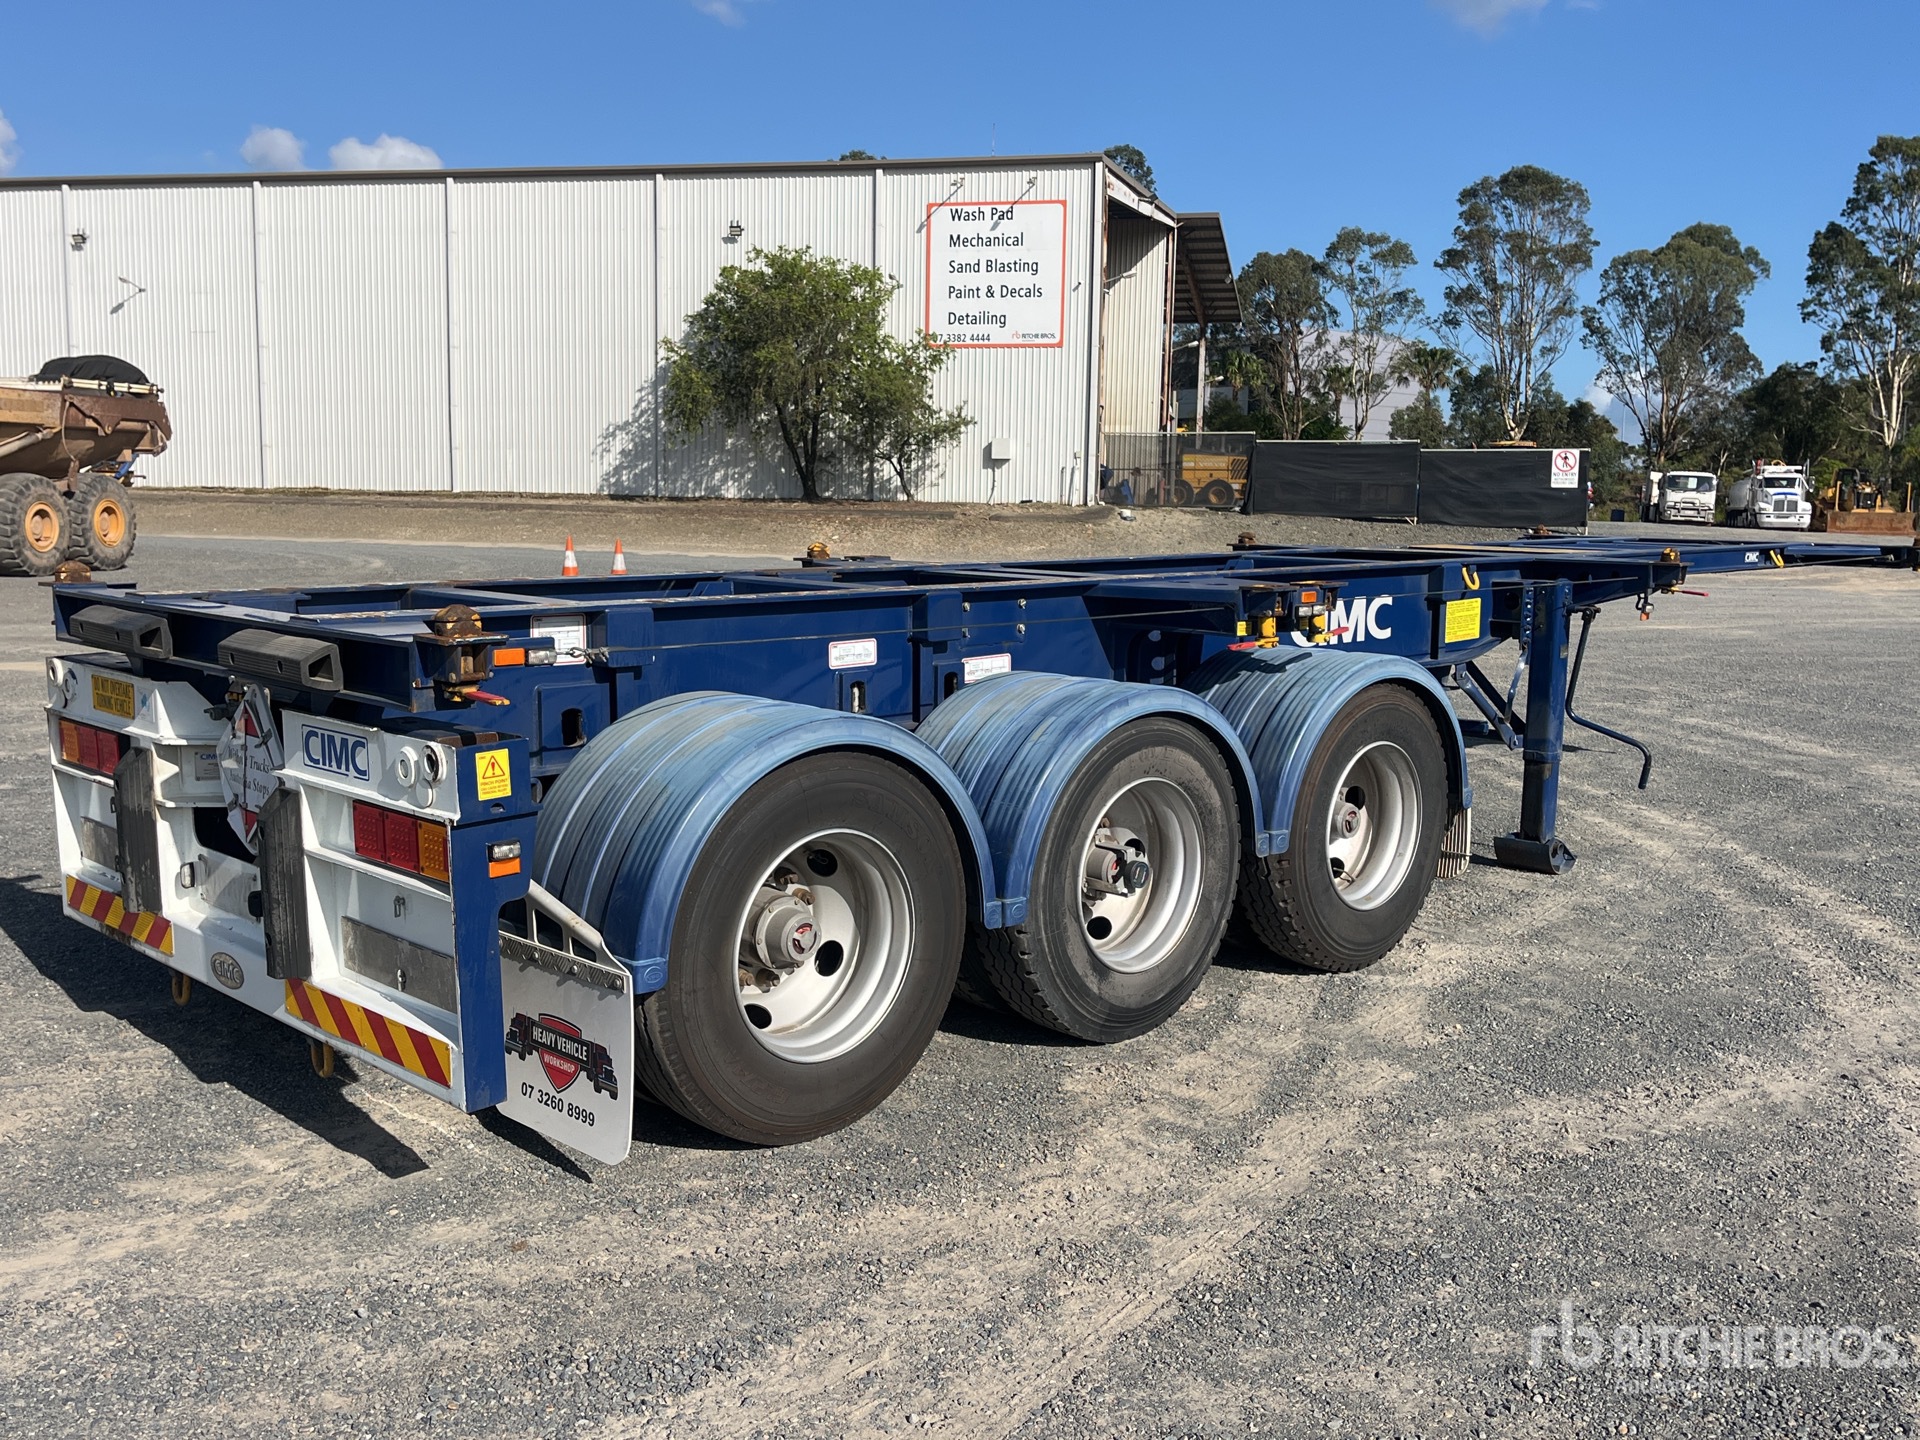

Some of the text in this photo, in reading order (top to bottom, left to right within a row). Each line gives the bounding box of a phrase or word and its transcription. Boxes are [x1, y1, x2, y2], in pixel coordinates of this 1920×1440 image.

[950, 205, 1014, 222] Wash Pad
[949, 232, 1024, 248] Mechanical
[949, 259, 1039, 276] Sand Blasting
[948, 283, 1043, 299] Paint & Decals
[947, 311, 1007, 328] Detailing
[946, 333, 967, 343] 3382
[969, 333, 991, 342] 4444
[200, 752, 218, 761] CIM
[304, 729, 368, 777] CIMC
[249, 755, 270, 775] Trucks
[252, 777, 270, 799] Stops
[214, 959, 241, 984] CIMC
[532, 1025, 587, 1061] HEAVY VEHICLE
[543, 1053, 575, 1073] WORKSHOP
[521, 1081, 595, 1127] 07 3260 8999
